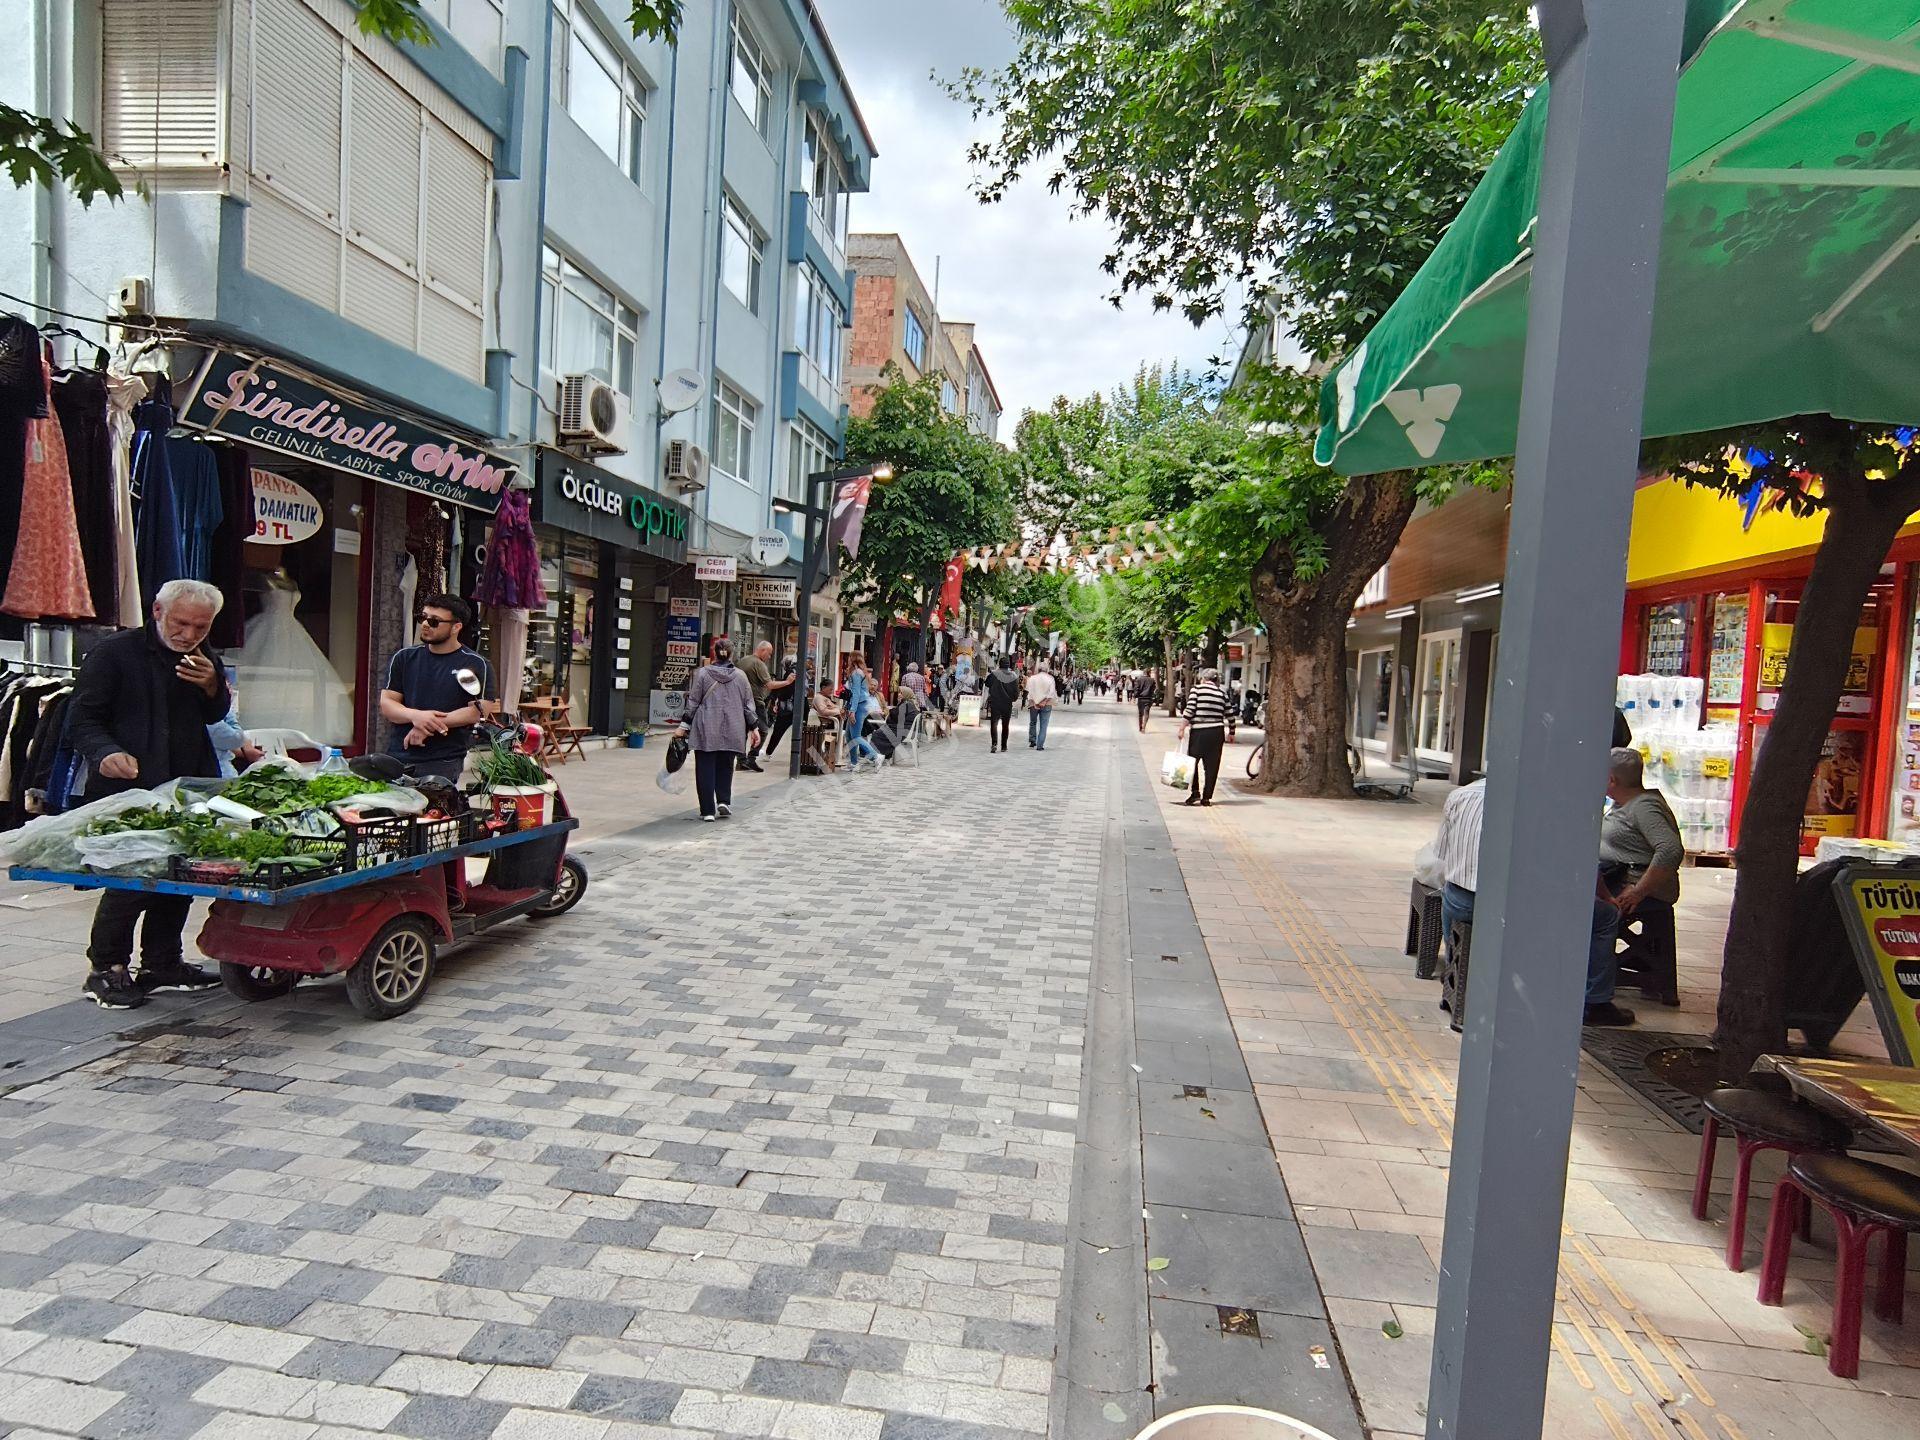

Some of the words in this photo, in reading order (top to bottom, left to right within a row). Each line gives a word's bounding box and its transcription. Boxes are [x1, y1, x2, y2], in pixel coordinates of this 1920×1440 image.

[203, 370, 408, 462] Sindirella
[411, 443, 506, 495] GİYİM
[250, 425, 330, 460] GELİNLİK
[341, 456, 385, 476] ABİYE
[394, 470, 429, 491] SPOR
[432, 481, 468, 501] GİYİM
[562, 467, 623, 517] ÖLÇÜLER
[259, 496, 318, 526] DAMATLIK
[272, 521, 294, 541] TL
[706, 558, 727, 566] CEM
[697, 567, 735, 576] BERBER
[762, 582, 792, 593] HEKİMİ
[1880, 928, 1919, 944] TÜTÜN
[1898, 972, 1920, 986] MAK
